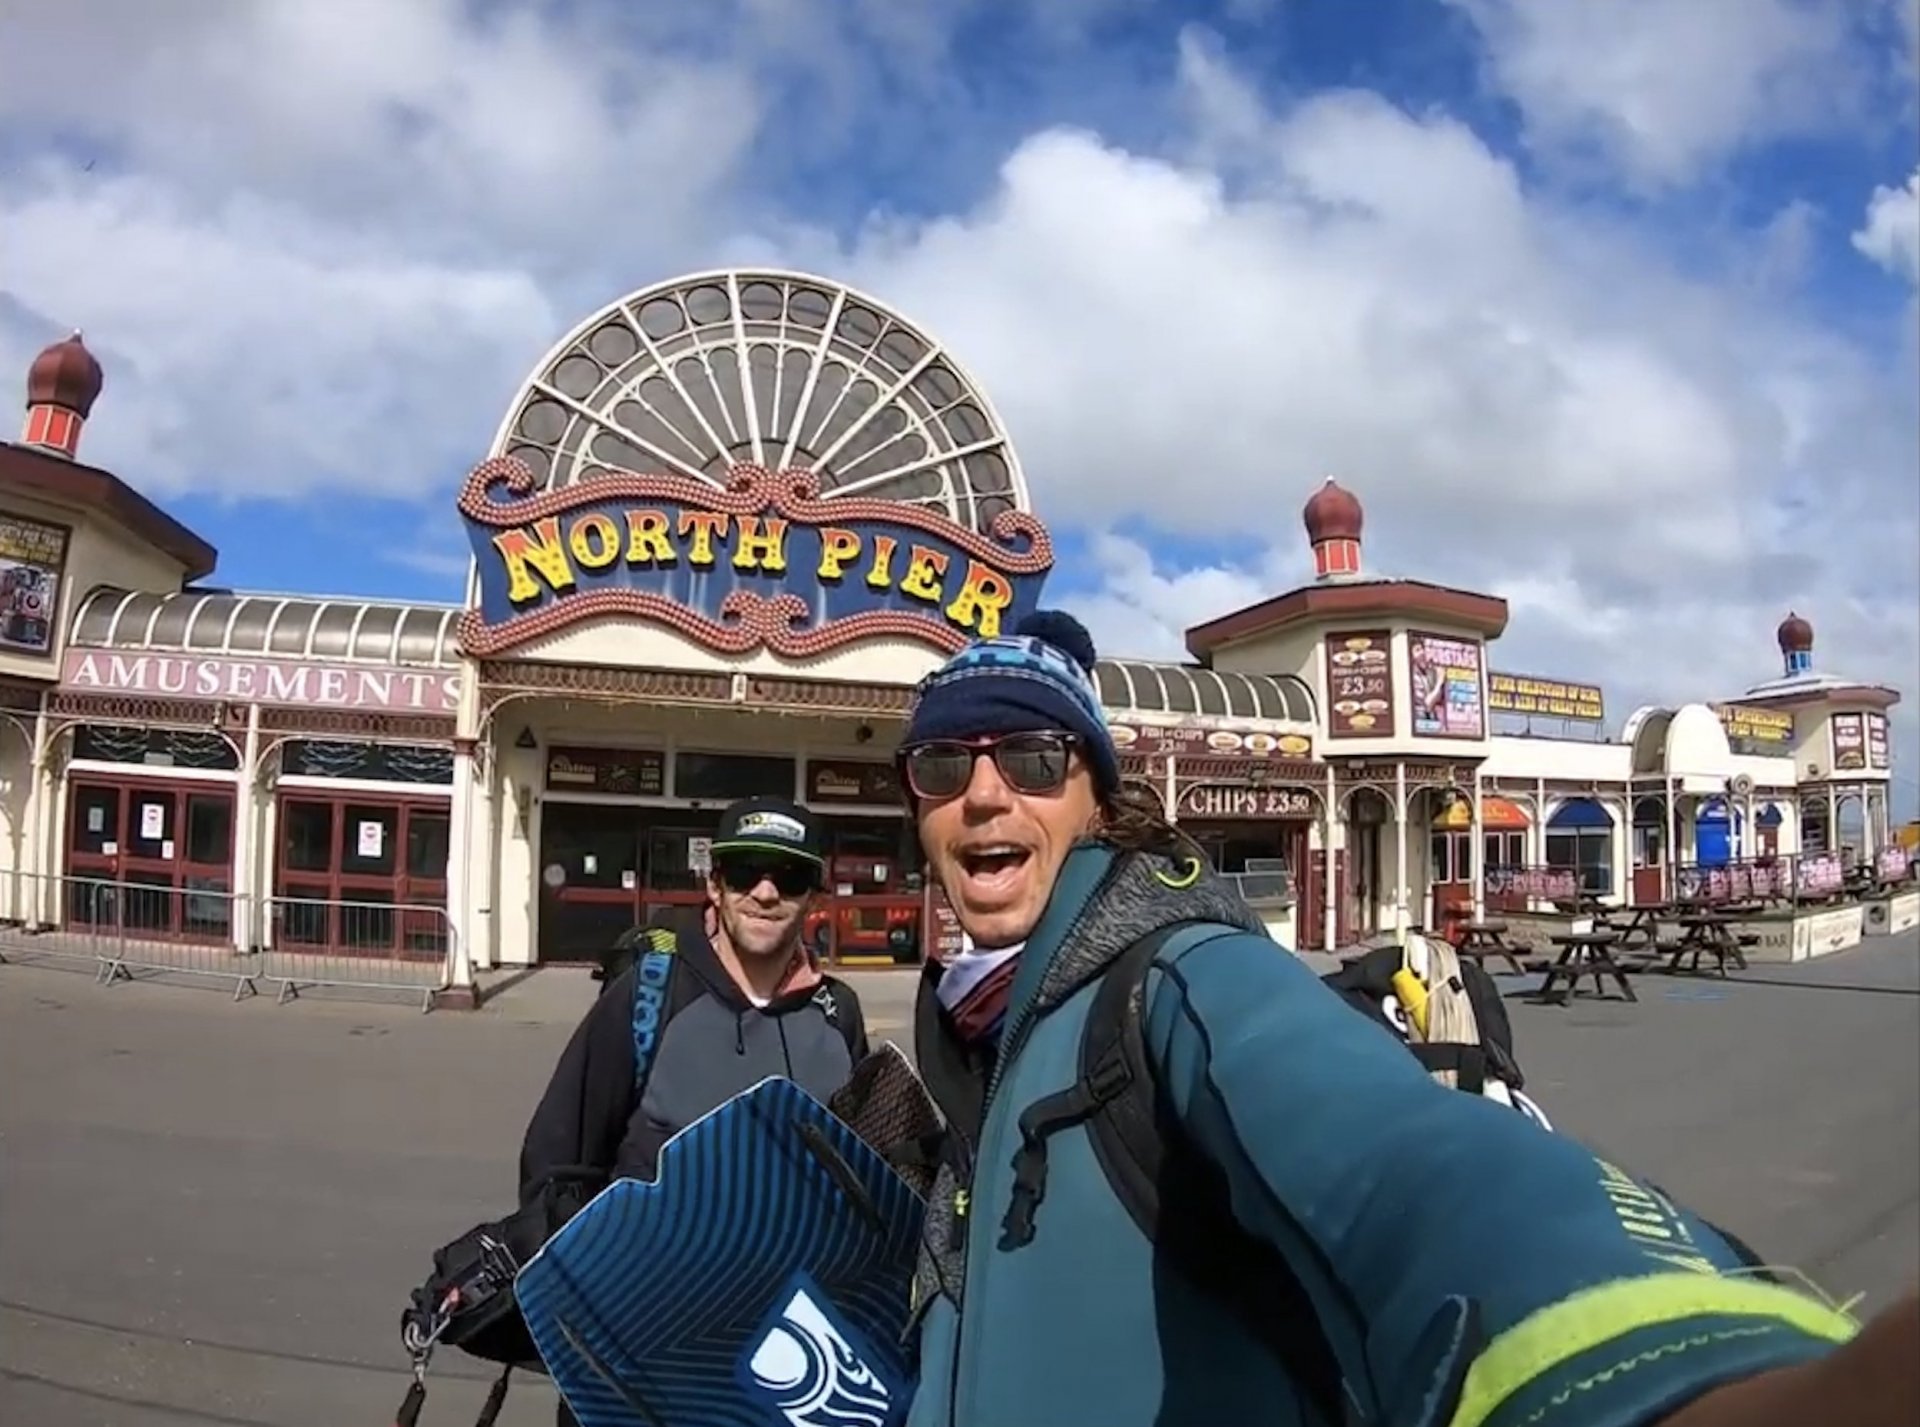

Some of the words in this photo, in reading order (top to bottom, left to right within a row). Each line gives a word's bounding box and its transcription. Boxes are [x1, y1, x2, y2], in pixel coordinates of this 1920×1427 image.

[493, 508, 789, 602] NORTH
[816, 526, 1013, 638] PIER
[71, 653, 464, 707] AMUSEMENTS
[1189, 788, 1258, 813] CHIPS
[1764, 931, 1790, 947] BAR
